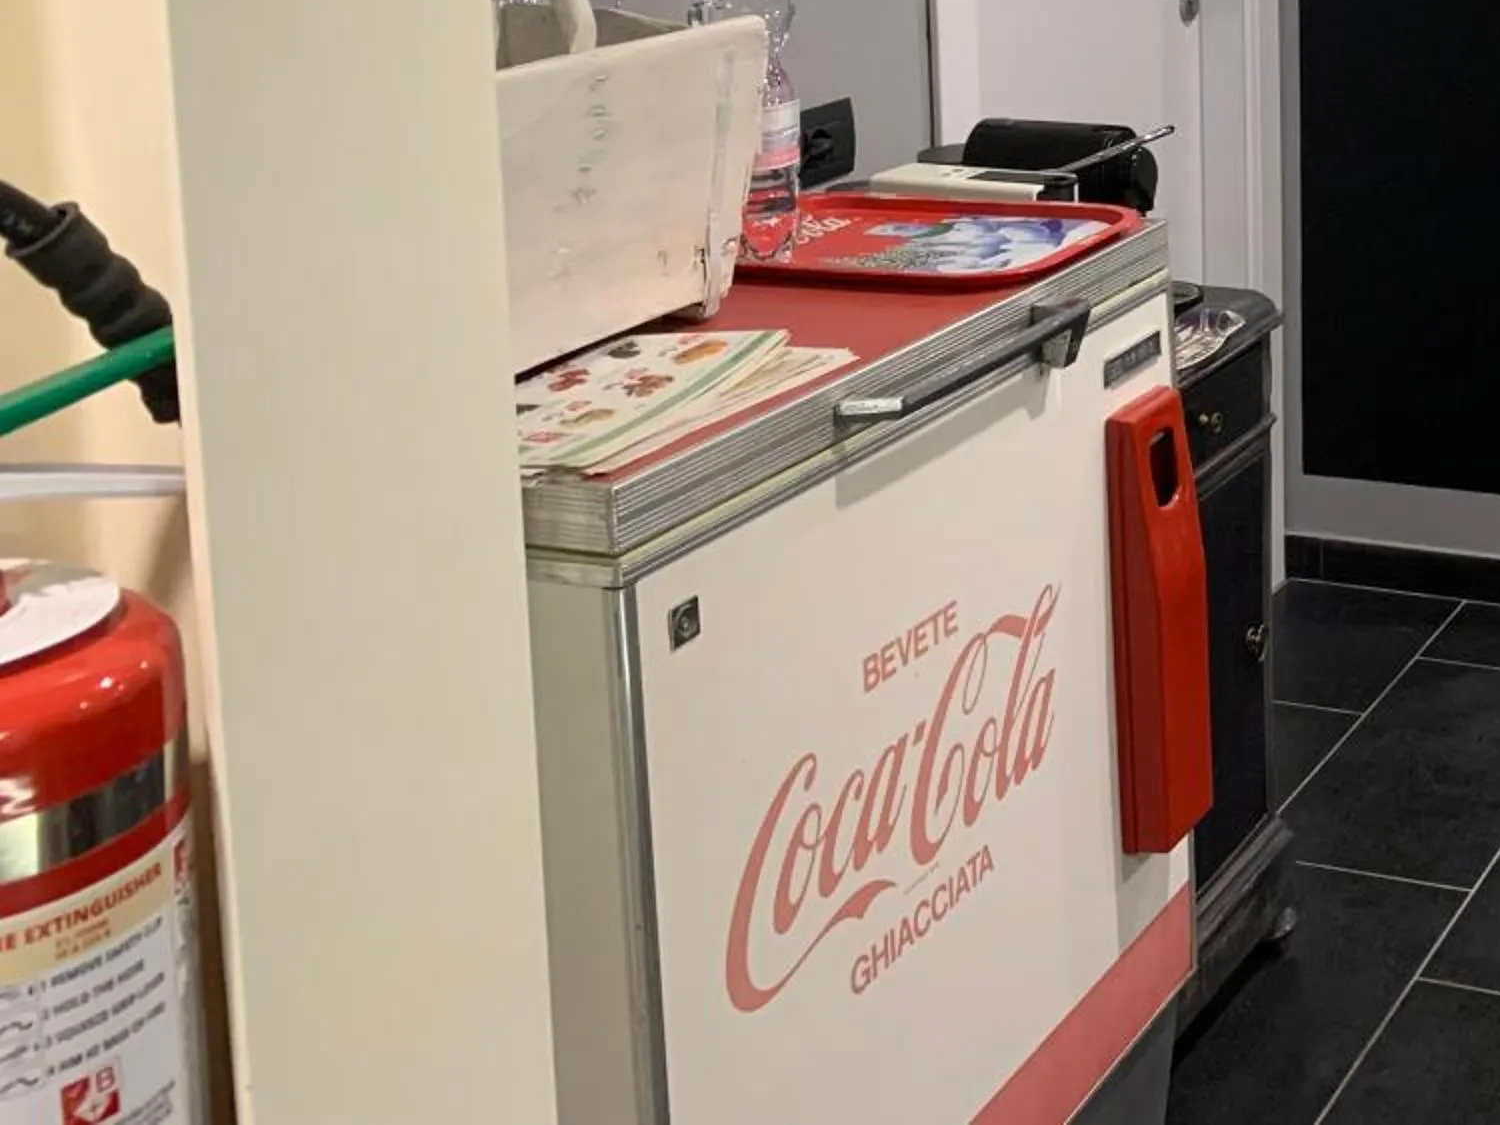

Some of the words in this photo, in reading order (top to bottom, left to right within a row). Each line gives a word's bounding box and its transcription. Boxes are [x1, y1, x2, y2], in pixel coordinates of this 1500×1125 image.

[862, 599, 960, 694] BEVETE
[24, 861, 162, 946] EXTINGUISHER
[849, 844, 996, 996] GHIACCIATA
